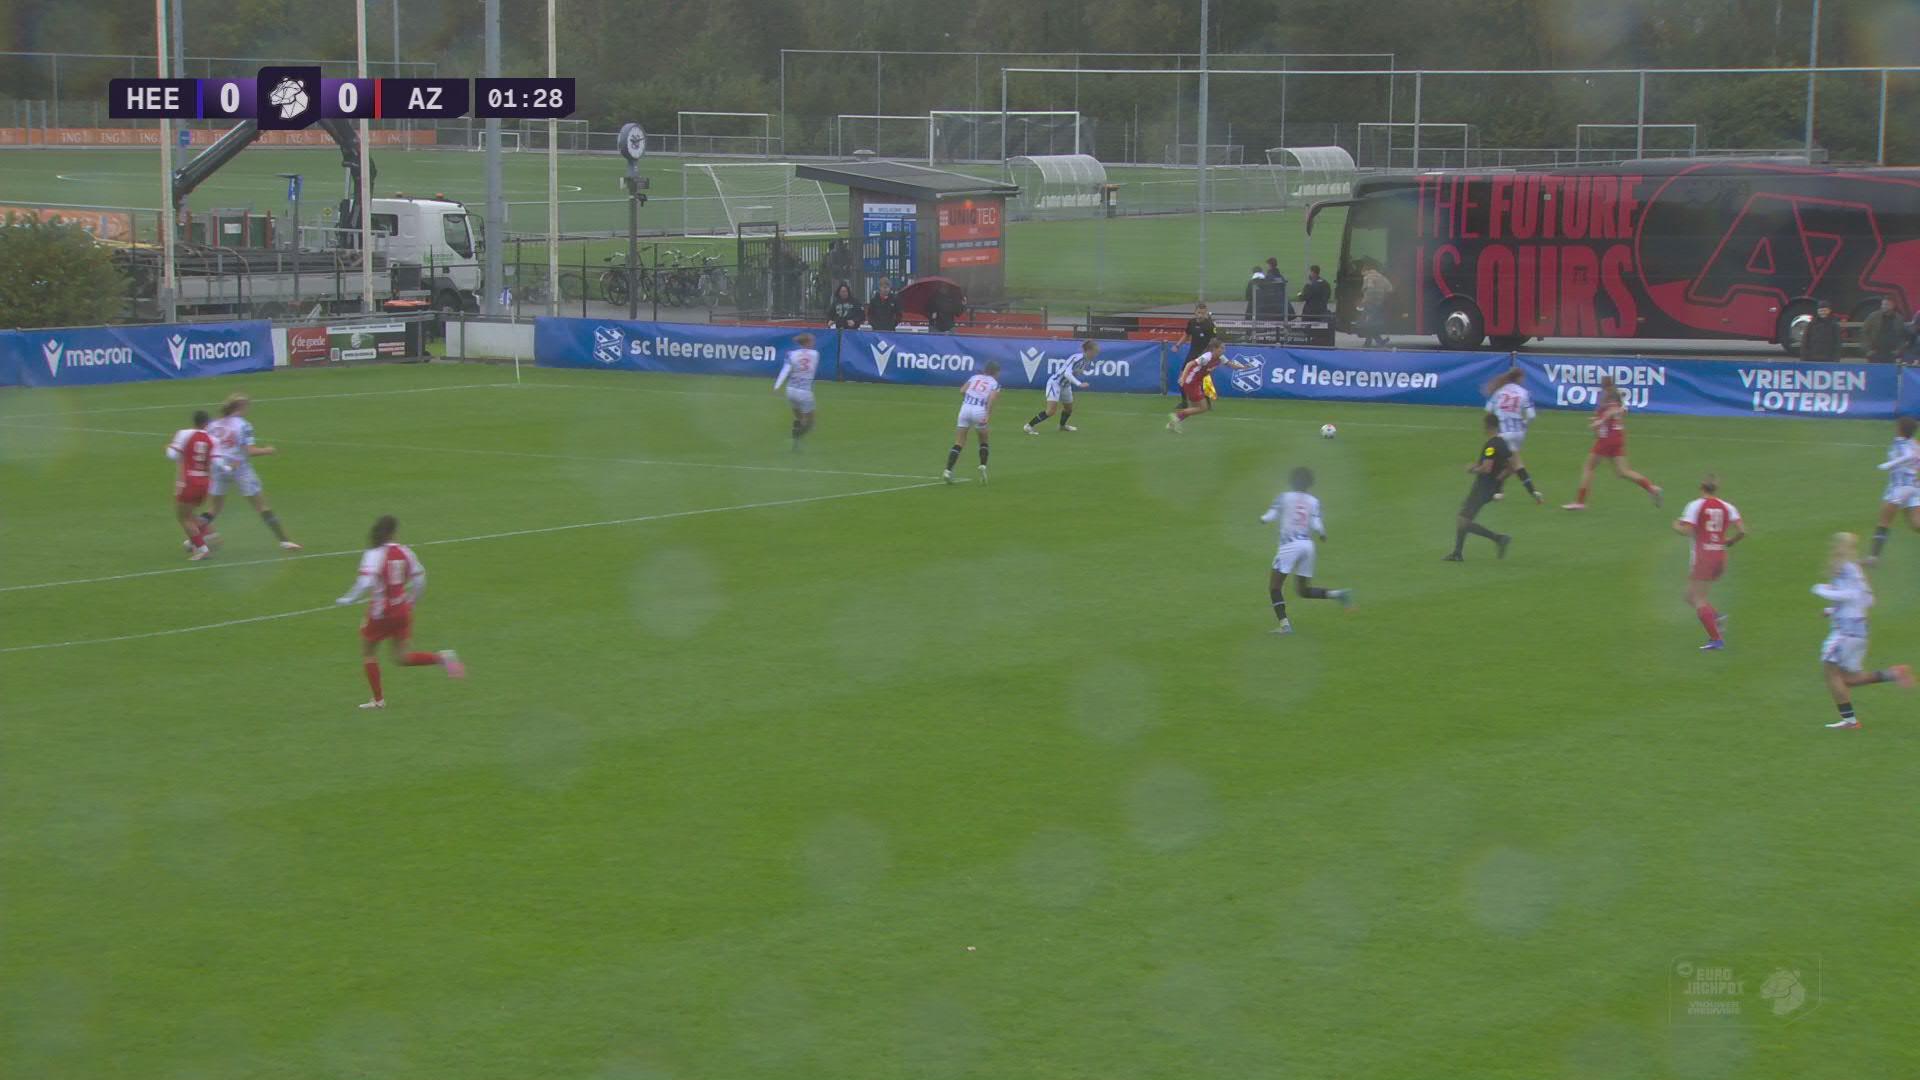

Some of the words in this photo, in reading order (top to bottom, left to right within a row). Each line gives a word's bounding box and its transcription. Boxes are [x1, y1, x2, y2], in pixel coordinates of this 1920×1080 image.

[62, 131, 82, 143] ING
[101, 132, 120, 143] ING
[139, 131, 158, 143] ING
[1415, 175, 1483, 240] THE
[1489, 174, 1643, 240] FUTURE
[1687, 191, 1900, 314] AZ
[1476, 244, 1638, 337] OURS
[65, 346, 133, 368] macron
[188, 339, 251, 361] macron
[630, 338, 651, 355] sc
[655, 336, 777, 361] Heerenveen
[896, 351, 975, 372] macron
[1047, 357, 1130, 377] mcron
[1270, 367, 1297, 384] sc
[1301, 364, 1439, 388] Heerenveen
[1543, 363, 1666, 386] VRIENDEN
[1738, 369, 1867, 391] VRIENDEN
[1556, 385, 1649, 409] LOTRIJ
[1753, 391, 1850, 415] LOTERIJ
